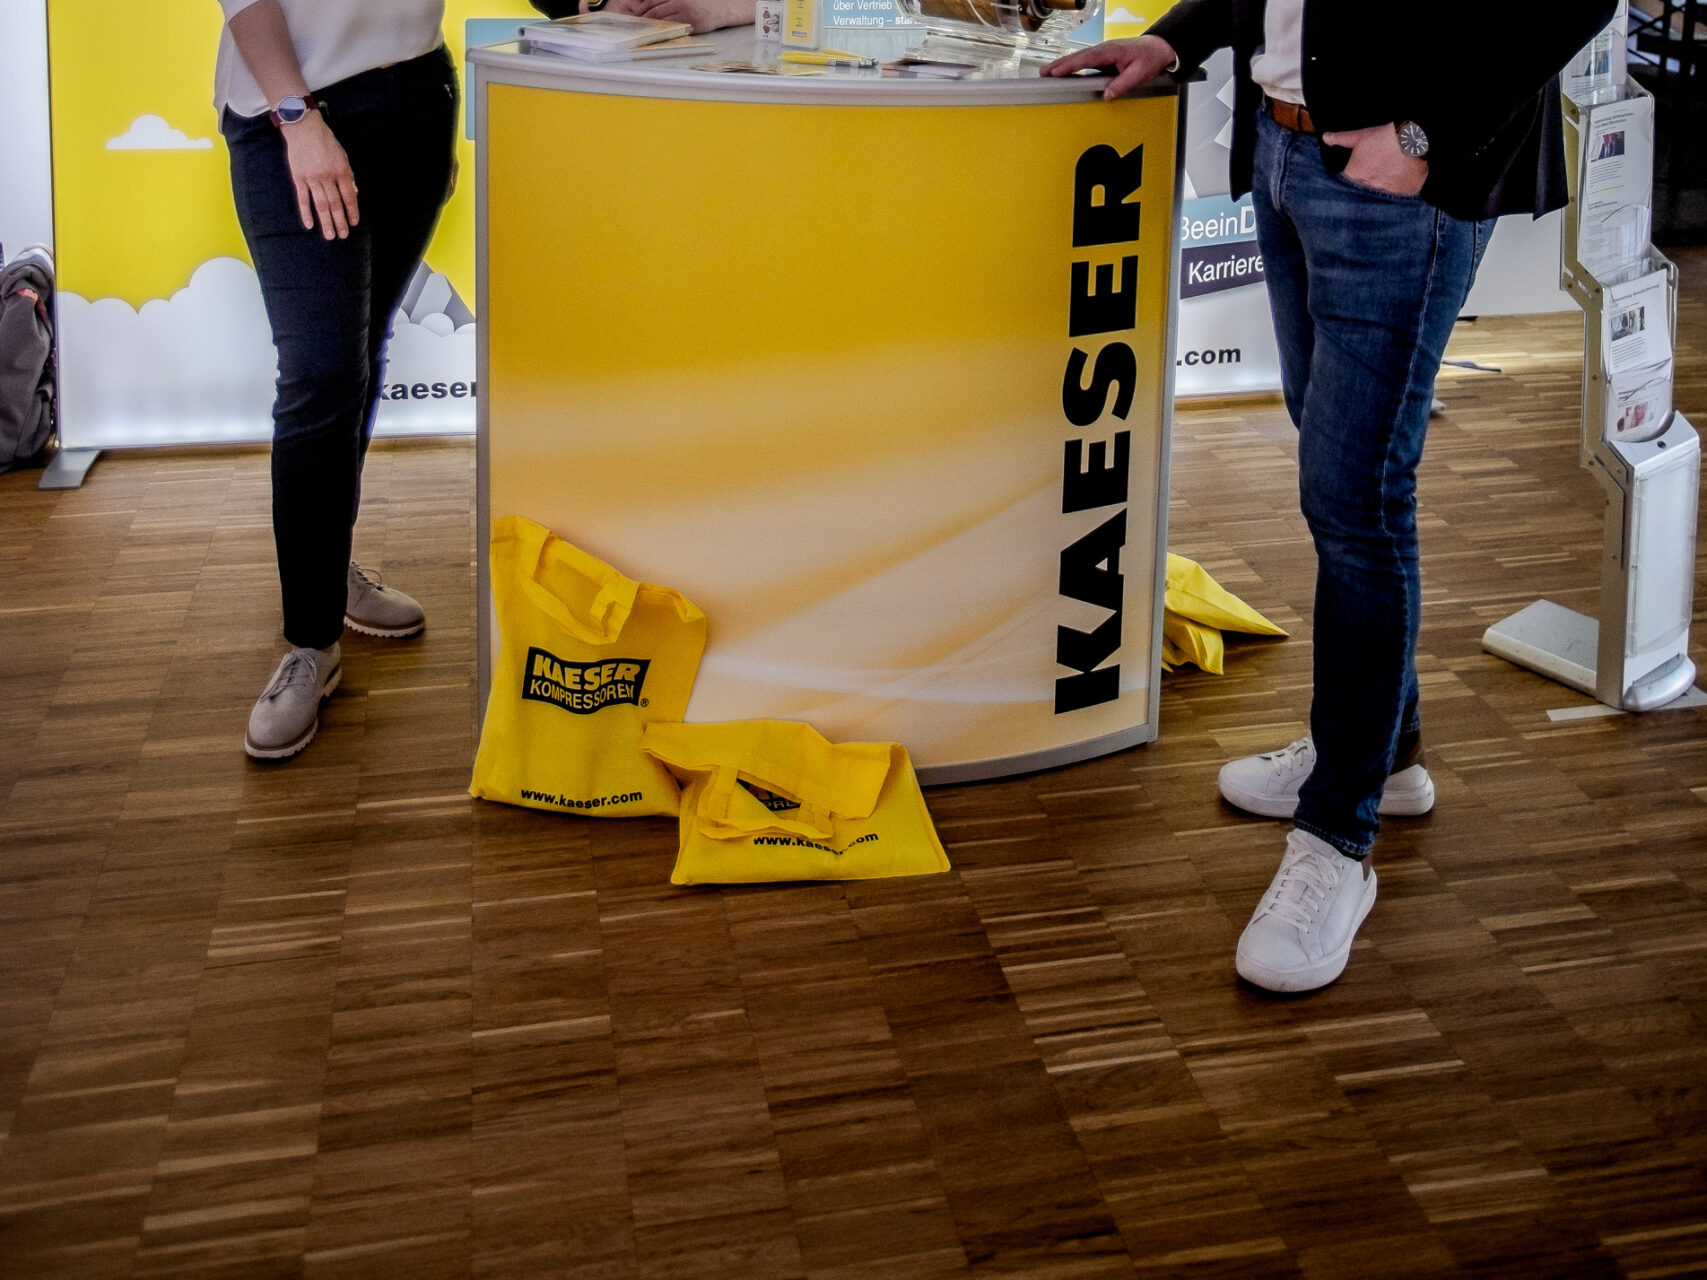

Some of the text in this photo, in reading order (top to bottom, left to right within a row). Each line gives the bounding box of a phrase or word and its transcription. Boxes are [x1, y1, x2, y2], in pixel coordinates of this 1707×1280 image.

[833, 0, 893, 10] über Vertrieb
[833, 15, 884, 27] Verwaltung
[1188, 254, 1264, 285] Karriere
[1176, 347, 1241, 367] .com
[1053, 142, 1144, 716] KAESER
[532, 654, 641, 691] KAESER
[529, 679, 635, 709] KOMPRESSOREN
[521, 789, 643, 810] www.kaeser.com
